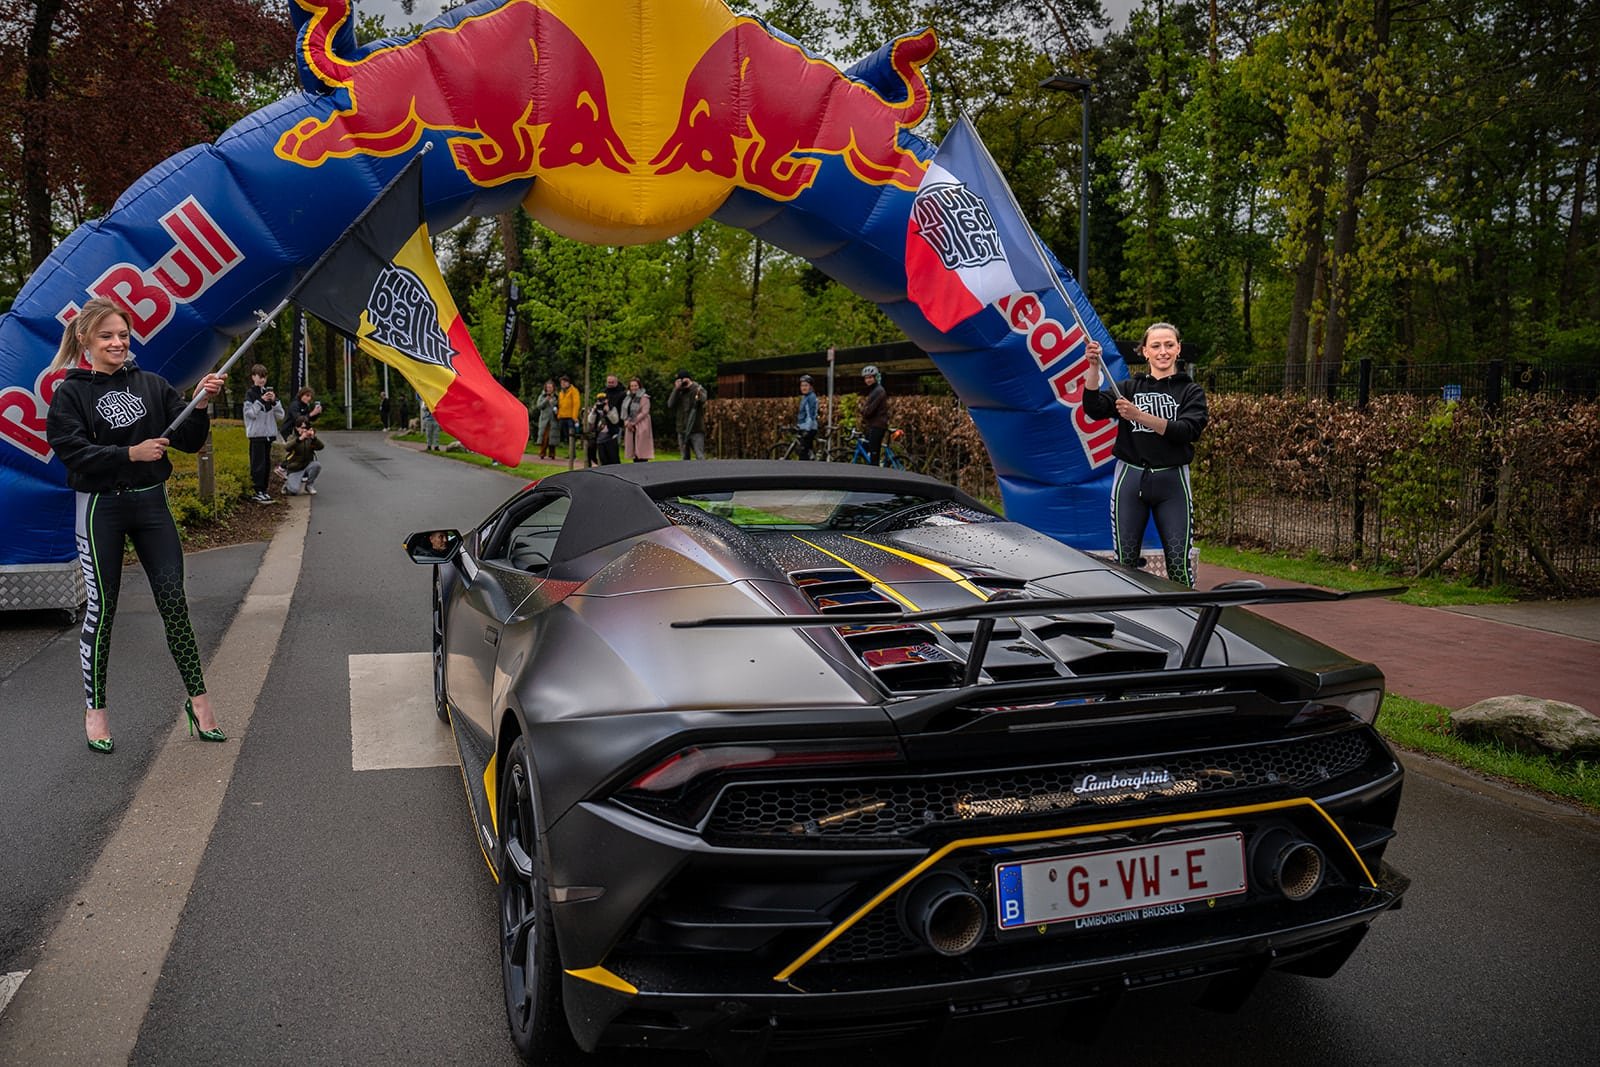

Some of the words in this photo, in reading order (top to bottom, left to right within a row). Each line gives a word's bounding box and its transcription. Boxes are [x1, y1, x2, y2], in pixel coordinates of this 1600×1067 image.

[86, 194, 245, 346] Bull
[990, 290, 1087, 372] ed
[76, 536, 99, 633] RUNBALL
[1073, 770, 1169, 794] Lamborghini
[1005, 900, 1020, 919] B
[1074, 910, 1139, 929] LAMBORGHINI
[1142, 903, 1185, 919] BRUSSELS
